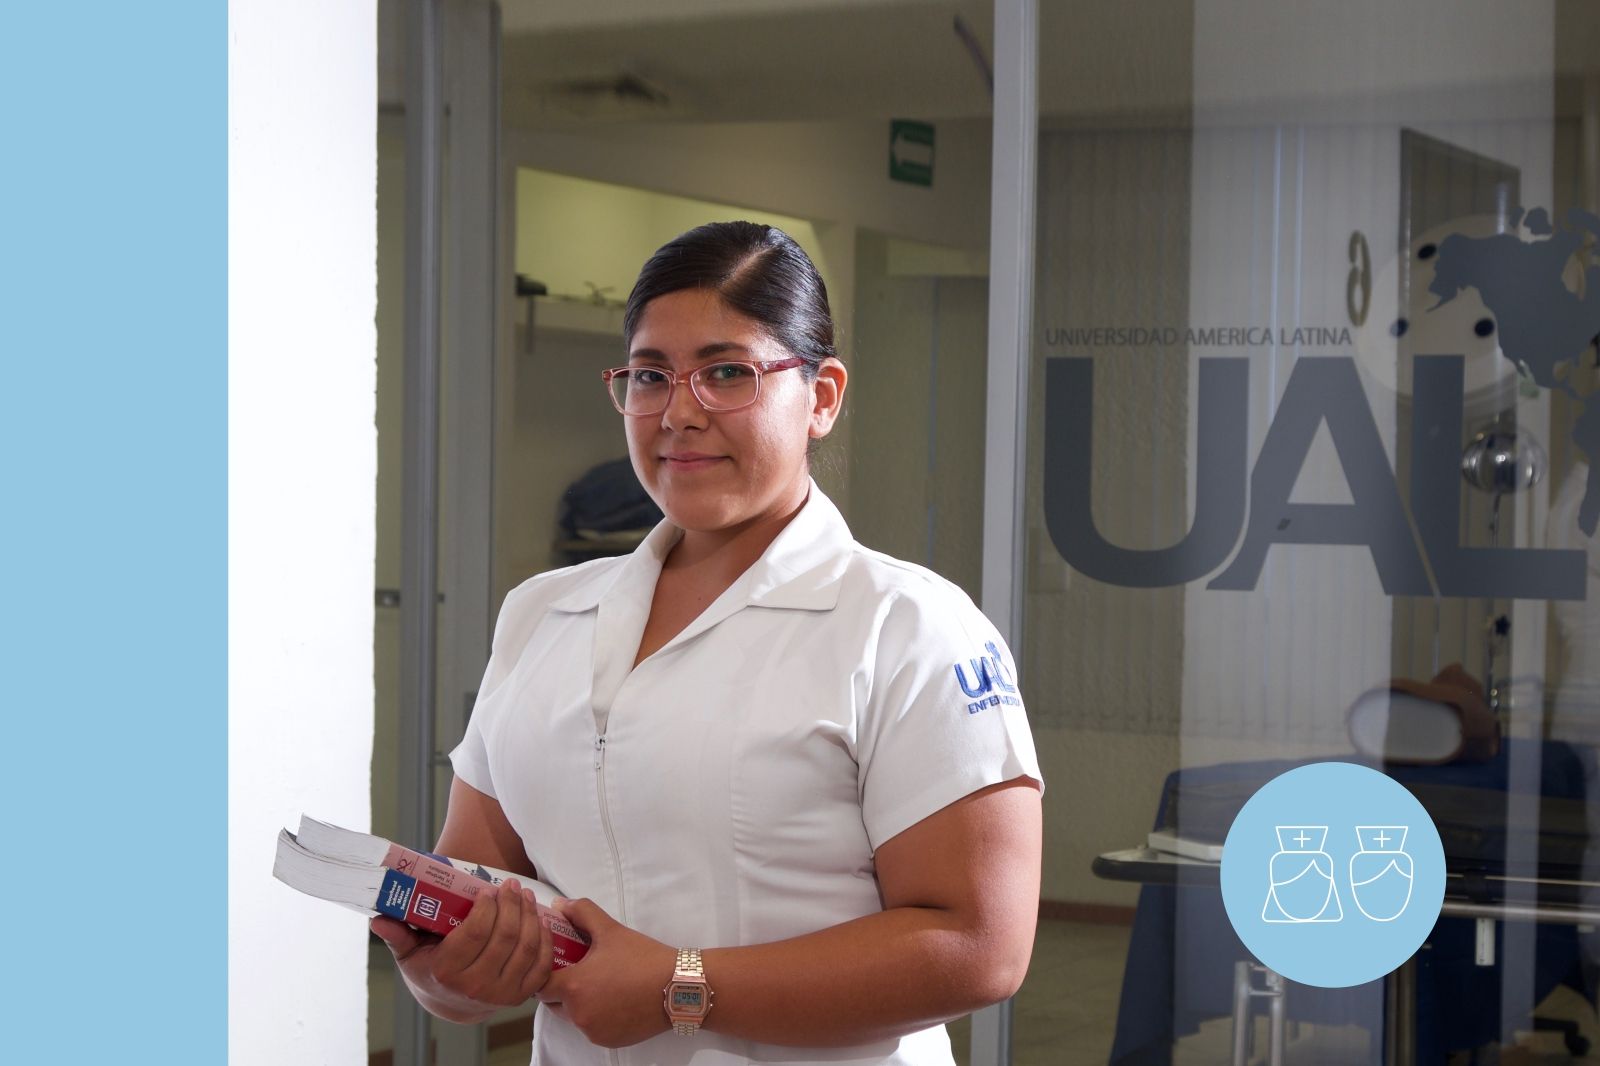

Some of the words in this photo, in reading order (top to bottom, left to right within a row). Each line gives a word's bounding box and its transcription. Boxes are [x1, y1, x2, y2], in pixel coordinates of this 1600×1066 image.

[1046, 327, 1177, 346] UNIVERSIDAD
[1185, 327, 1274, 346] AMERICA
[1281, 327, 1352, 346] LATINA
[1044, 354, 1587, 599] UAL
